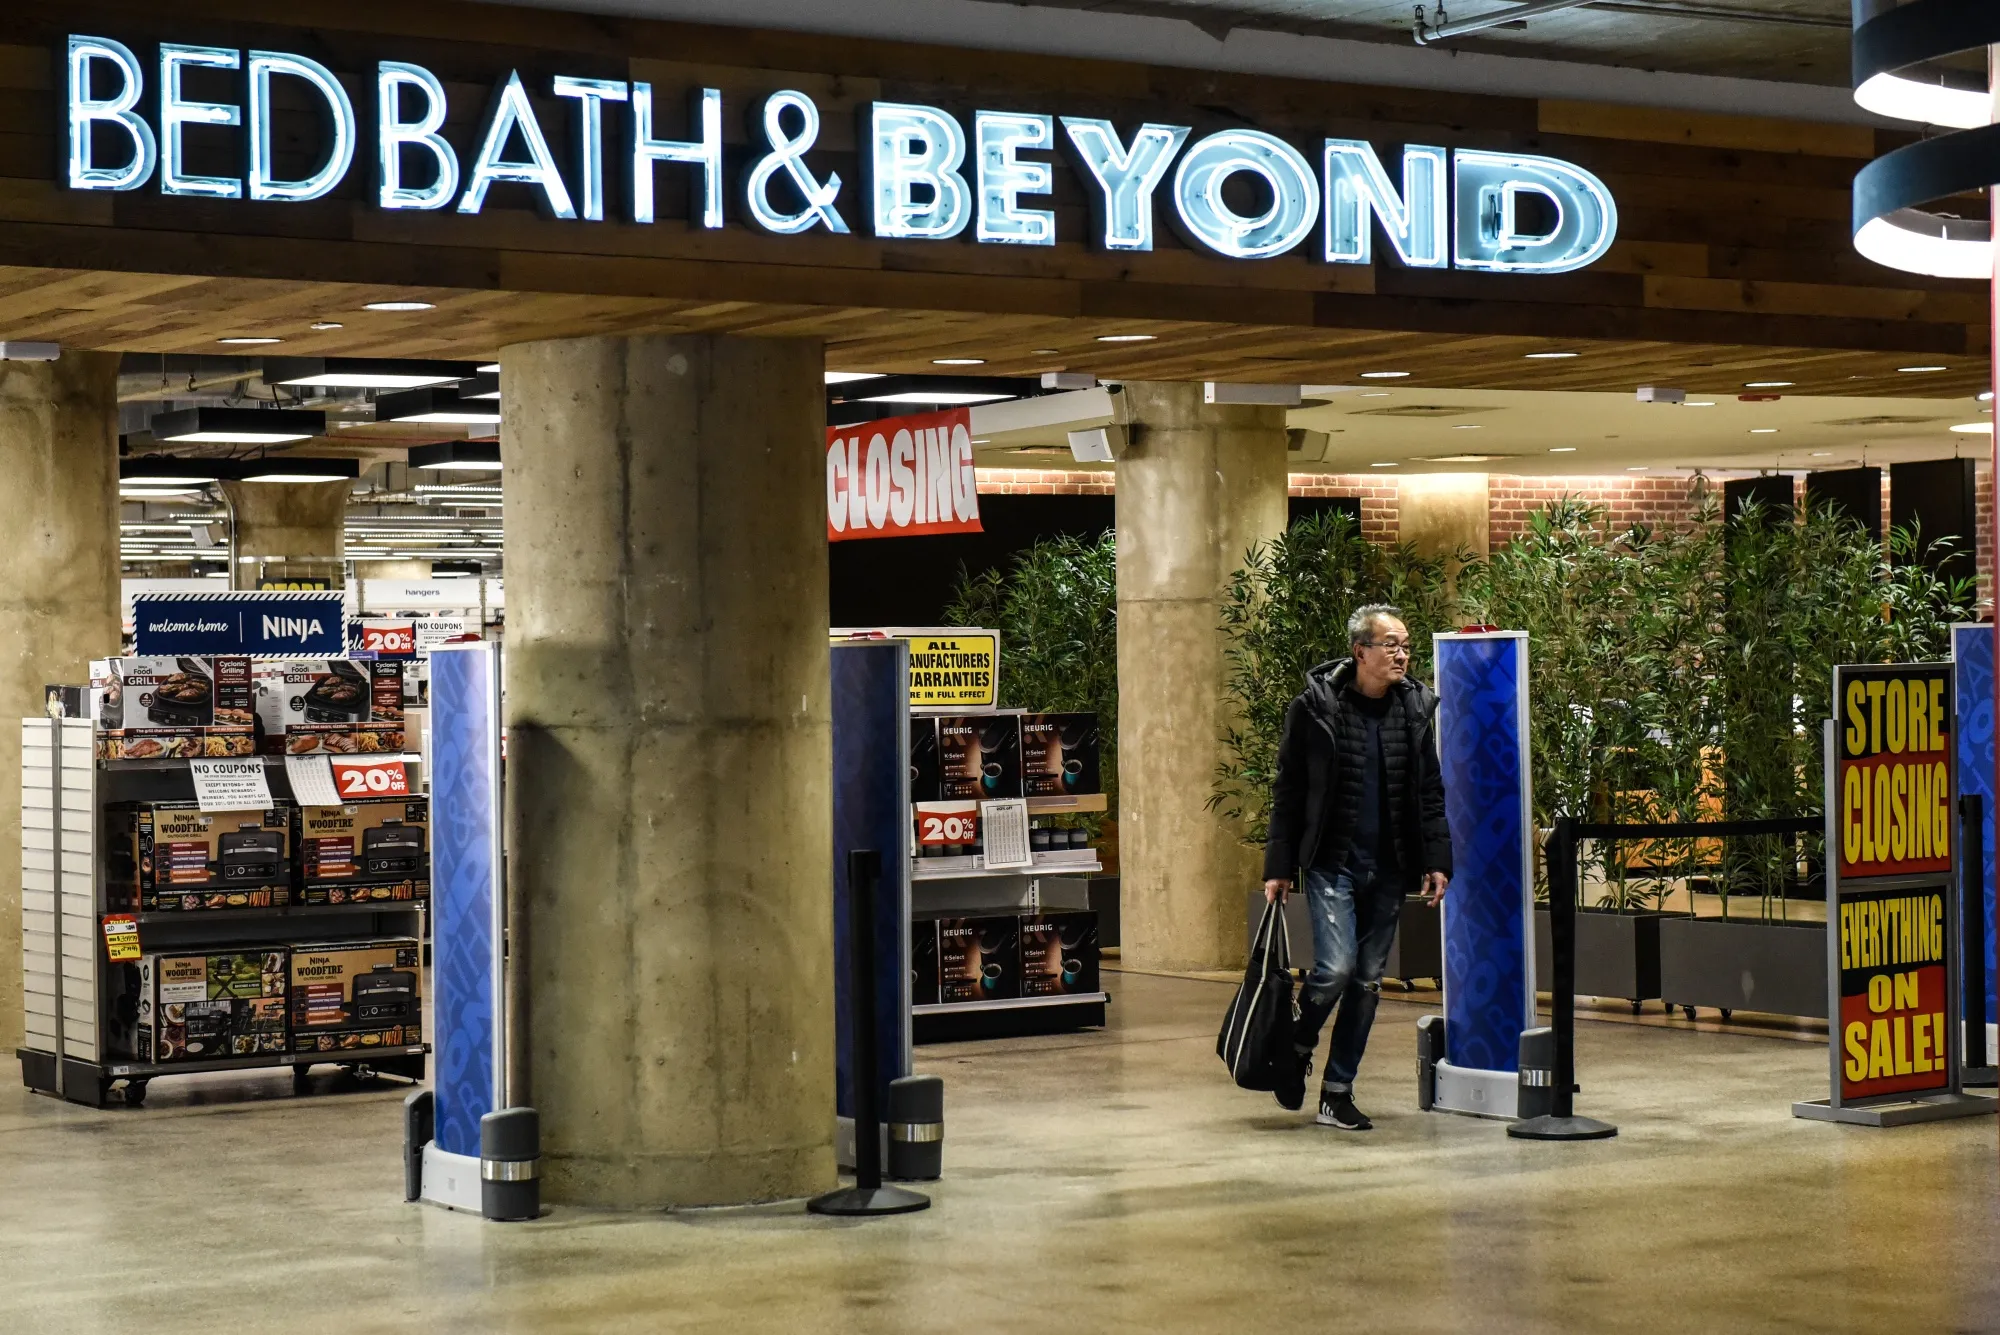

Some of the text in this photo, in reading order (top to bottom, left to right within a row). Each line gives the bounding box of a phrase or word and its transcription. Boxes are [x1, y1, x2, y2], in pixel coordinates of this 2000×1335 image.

[68, 34, 1618, 275] BED BATH & BEYOND
[827, 423, 979, 533] CLOSING
[405, 588, 441, 598] hangers
[148, 618, 229, 633] welcome home
[262, 614, 324, 644] NINJA
[417, 622, 463, 631] NO COUPONS
[927, 641, 960, 651] ALL
[910, 652, 990, 669] ANUFACTURERS
[127, 676, 159, 686] GRILL
[286, 674, 316, 683] GRILL
[910, 690, 986, 699] RE IN FULL EFFECT
[1845, 678, 1945, 756] STORE
[943, 726, 973, 735] KEURIG
[1024, 724, 1053, 732] KEURIG
[193, 763, 262, 774] NO COUPONS
[391, 780, 406, 791] OFF
[320, 809, 341, 819] NINJA
[1843, 761, 1948, 865] CLOSING
[173, 814, 195, 823] NINJA
[160, 823, 209, 834] WOODFIRE
[308, 818, 354, 830] WOODFIRE
[963, 830, 974, 840] OFF
[943, 928, 973, 937] KEURIG
[1023, 924, 1053, 933] KEURIG
[1840, 893, 1943, 970] EVERYTHING
[174, 961, 192, 969] NINJA
[309, 957, 330, 966] NINJA
[165, 968, 202, 977] WOODFIRE
[297, 965, 344, 977] WOODFIRE
[1868, 971, 1919, 1013] ON
[1845, 1012, 1944, 1082] SALE!
